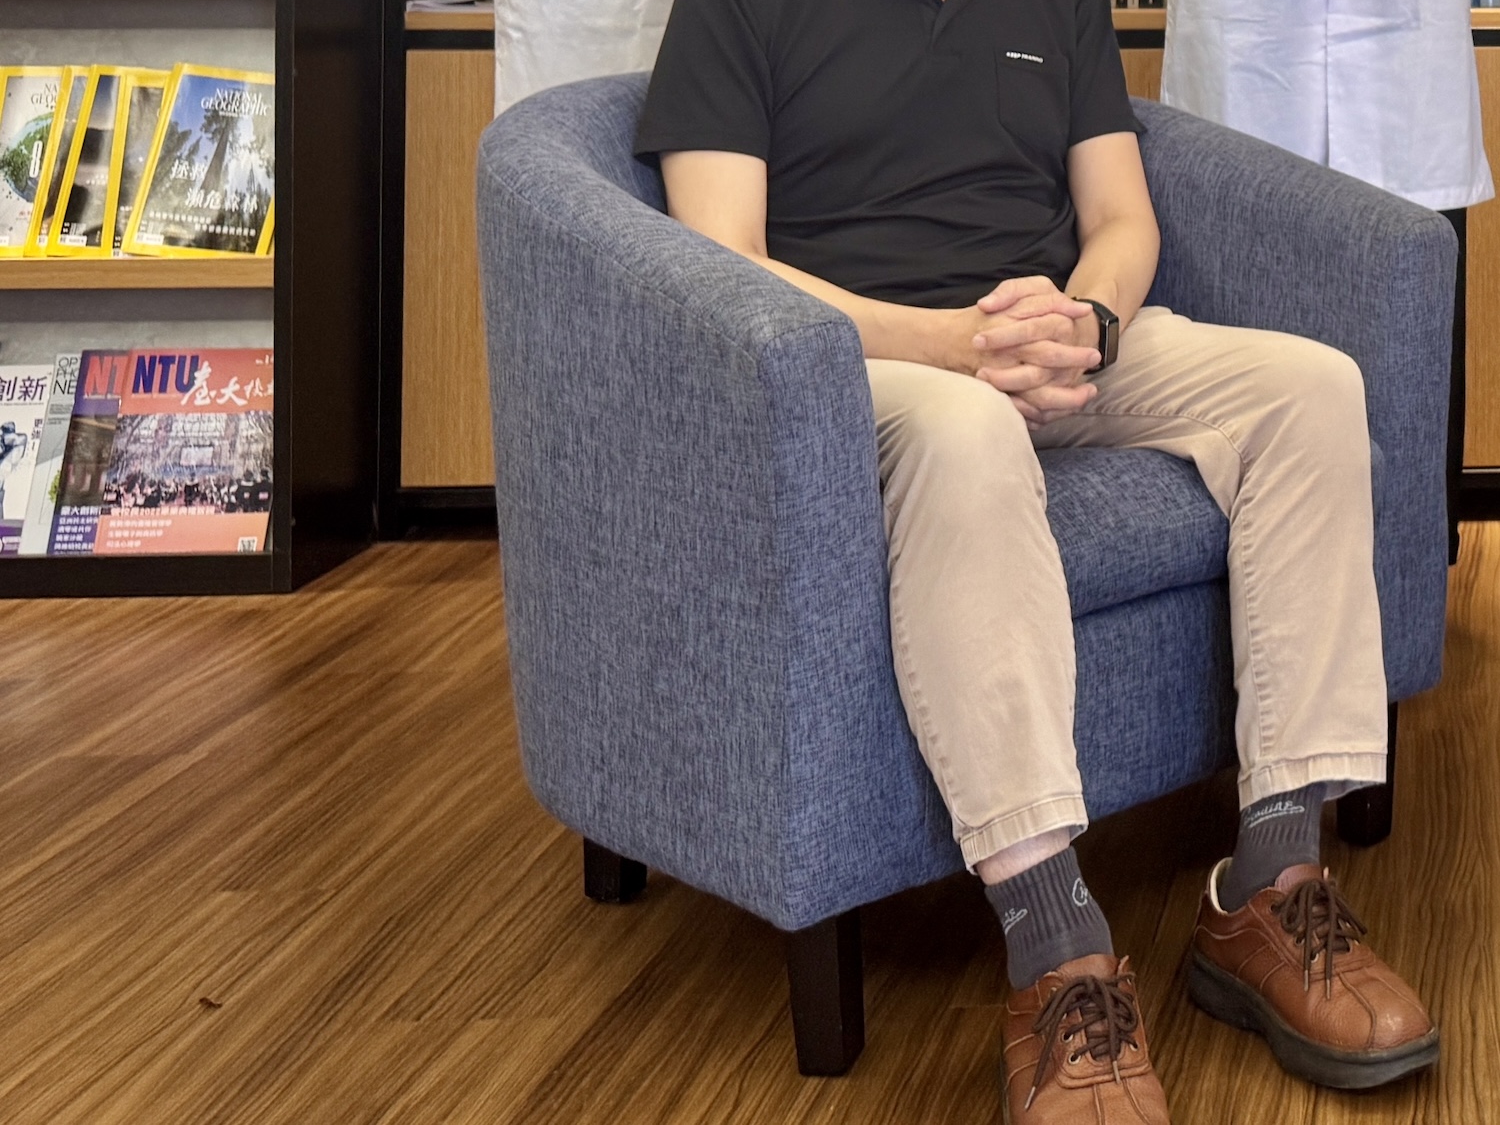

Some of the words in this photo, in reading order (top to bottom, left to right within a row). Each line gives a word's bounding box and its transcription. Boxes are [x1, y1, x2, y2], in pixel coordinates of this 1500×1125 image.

[53, 380, 76, 395] NE
[84, 356, 128, 394] NT
[132, 355, 199, 394] NTU
